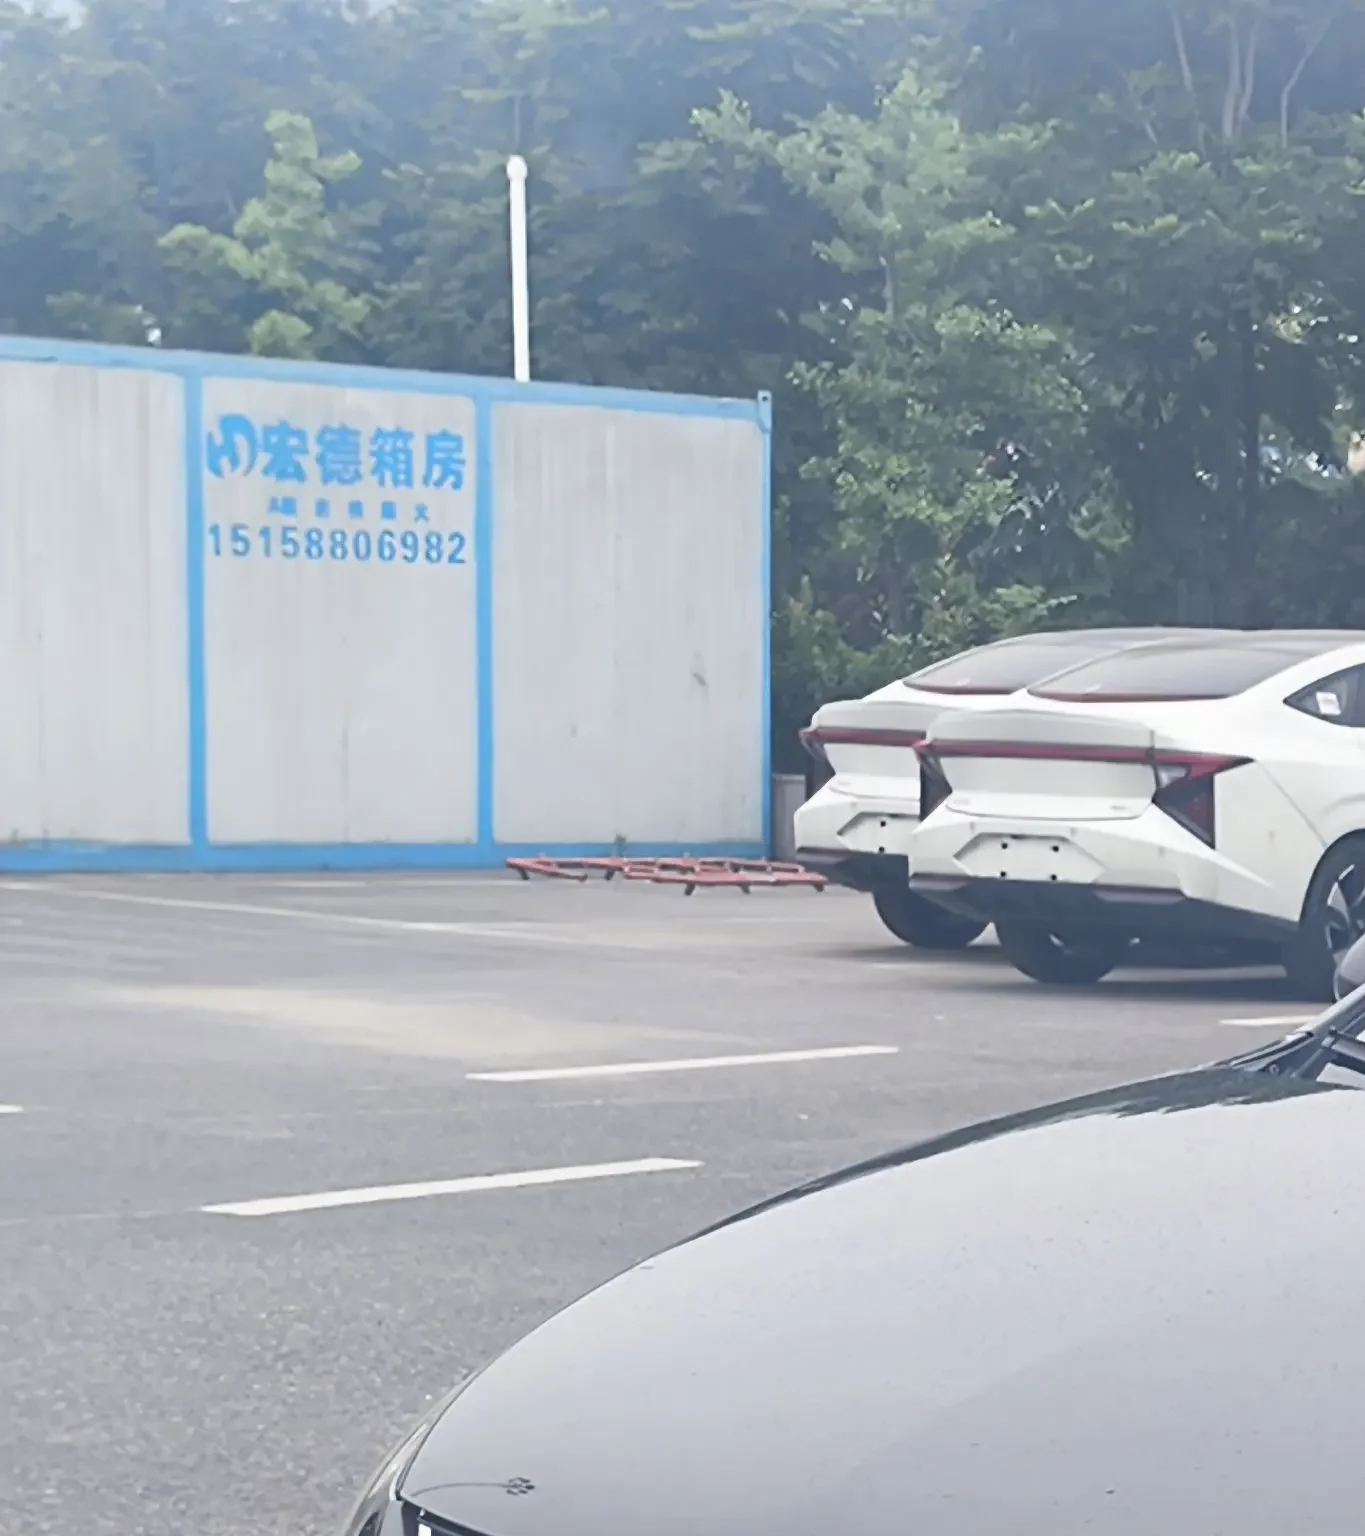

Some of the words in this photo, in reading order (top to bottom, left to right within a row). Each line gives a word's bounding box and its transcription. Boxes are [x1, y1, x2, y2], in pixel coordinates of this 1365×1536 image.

[260, 419, 467, 491] 宏德箱房
[207, 523, 467, 564] 15158806982
